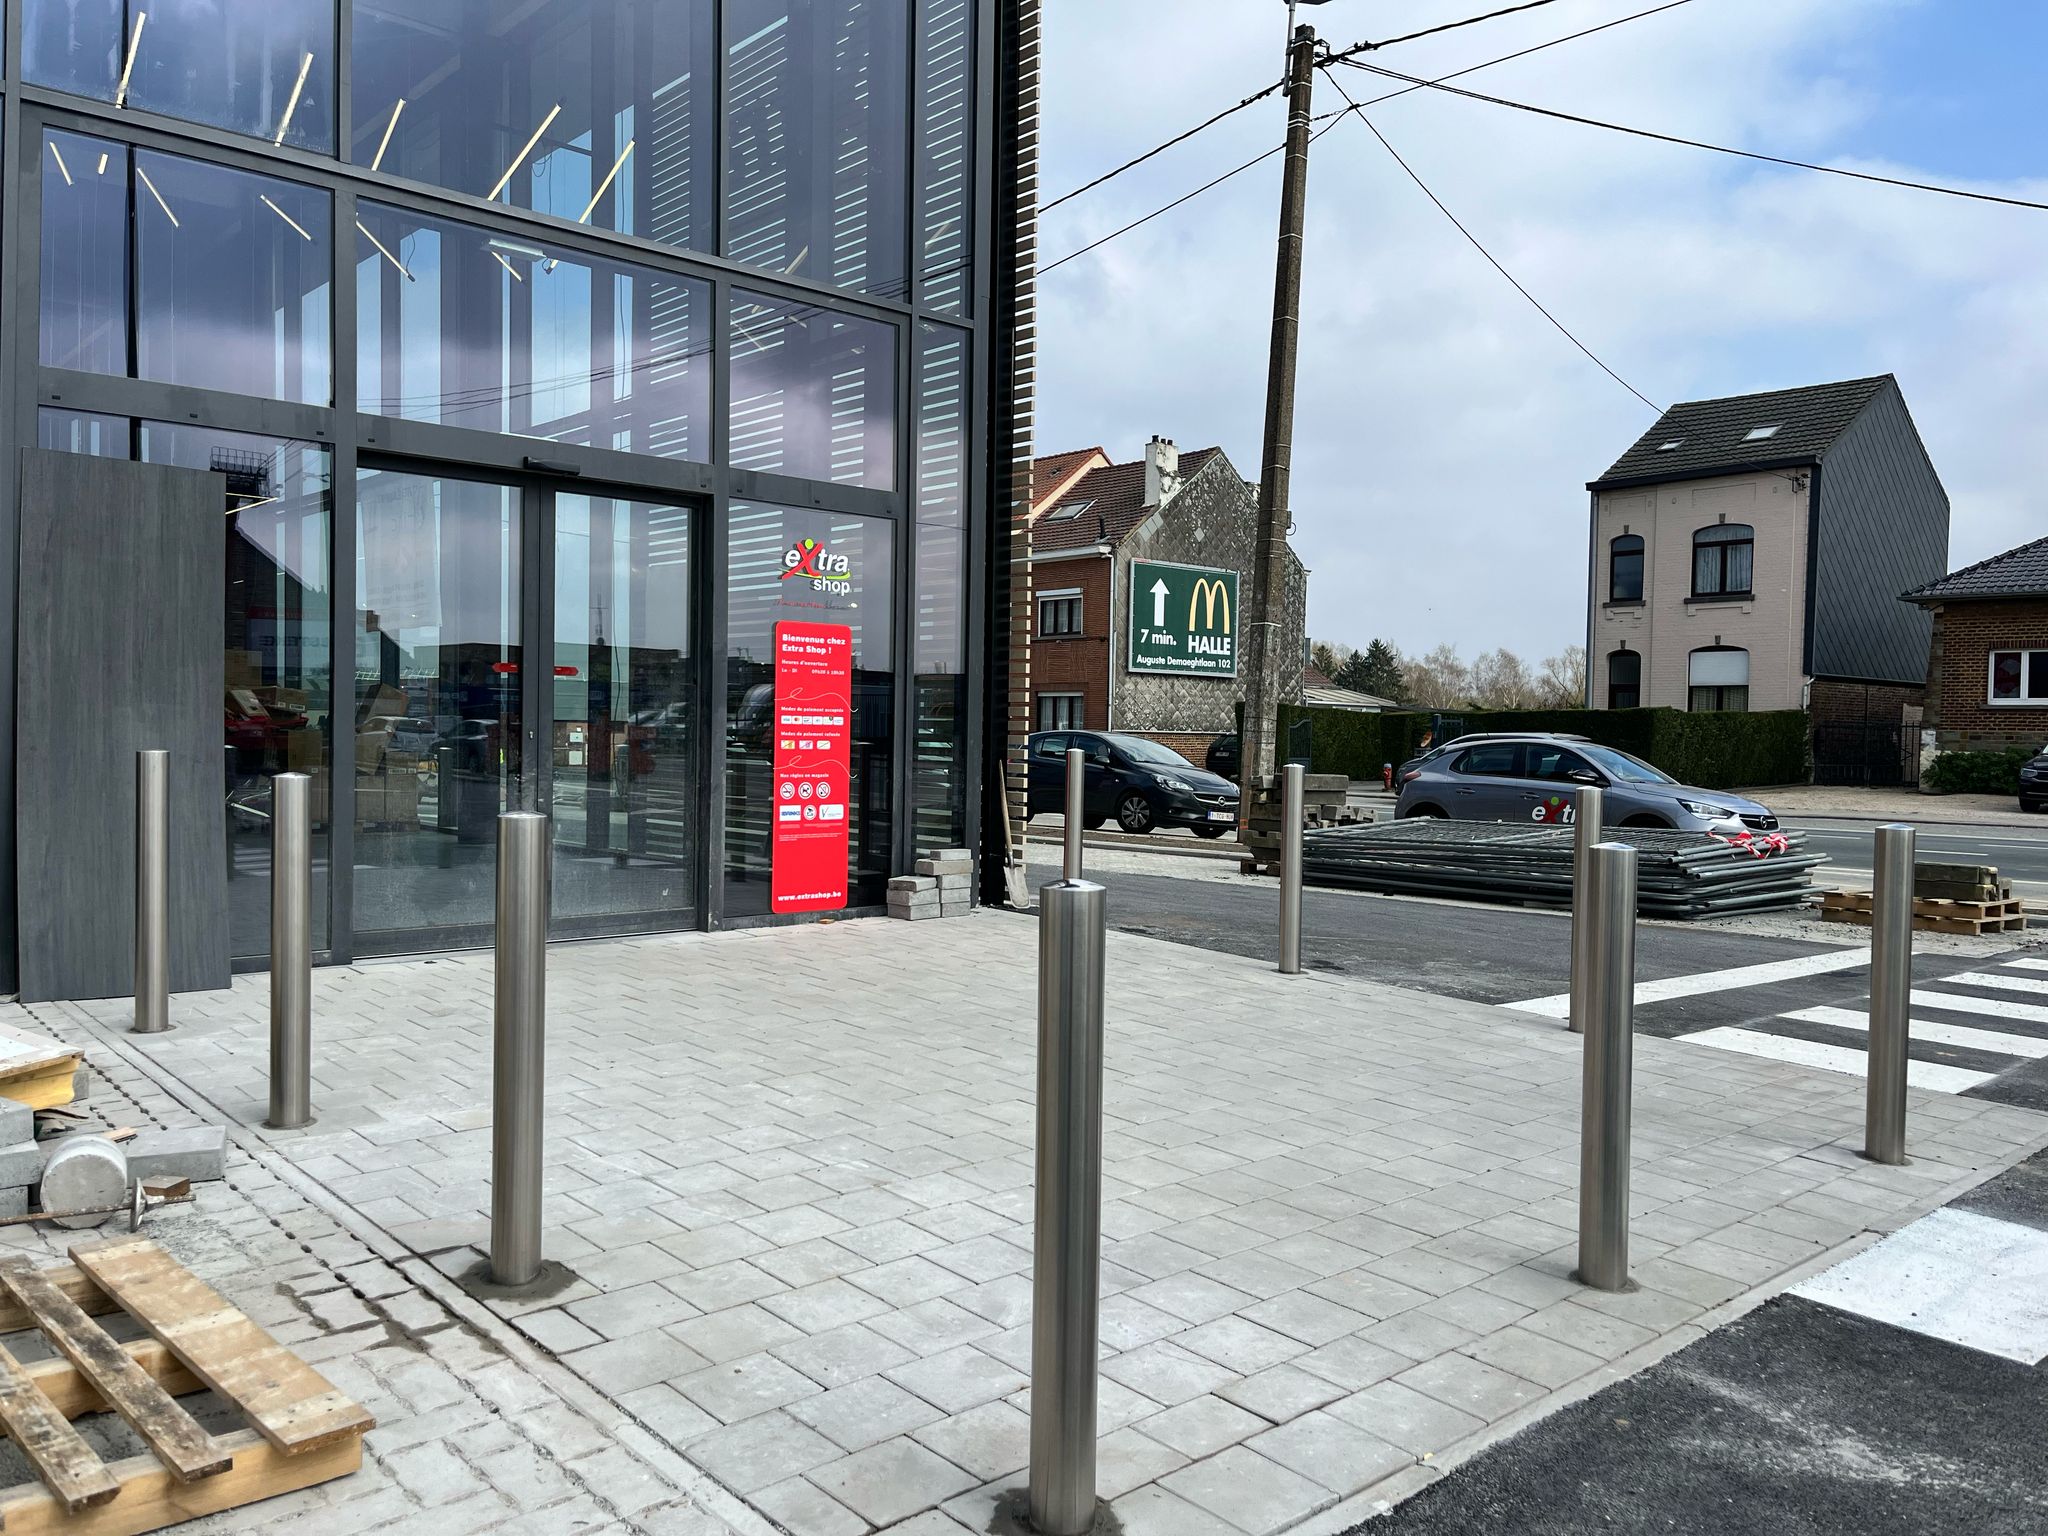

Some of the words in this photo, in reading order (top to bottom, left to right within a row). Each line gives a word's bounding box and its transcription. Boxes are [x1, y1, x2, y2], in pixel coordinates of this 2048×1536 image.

[813, 577, 850, 596] shop
[782, 633, 825, 644] Bienvenue
[826, 637, 846, 645] chez
[1140, 628, 1149, 643] 7
[1151, 630, 1177, 645] min.
[782, 644, 804, 653] Extra
[806, 645, 827, 655] Shop
[1188, 635, 1231, 655] HALLE
[1136, 654, 1165, 666] Auguste
[1167, 656, 1216, 668] Demaeghtlaan
[1218, 659, 1231, 668] 102
[777, 891, 842, 902] www.extrashop.be
